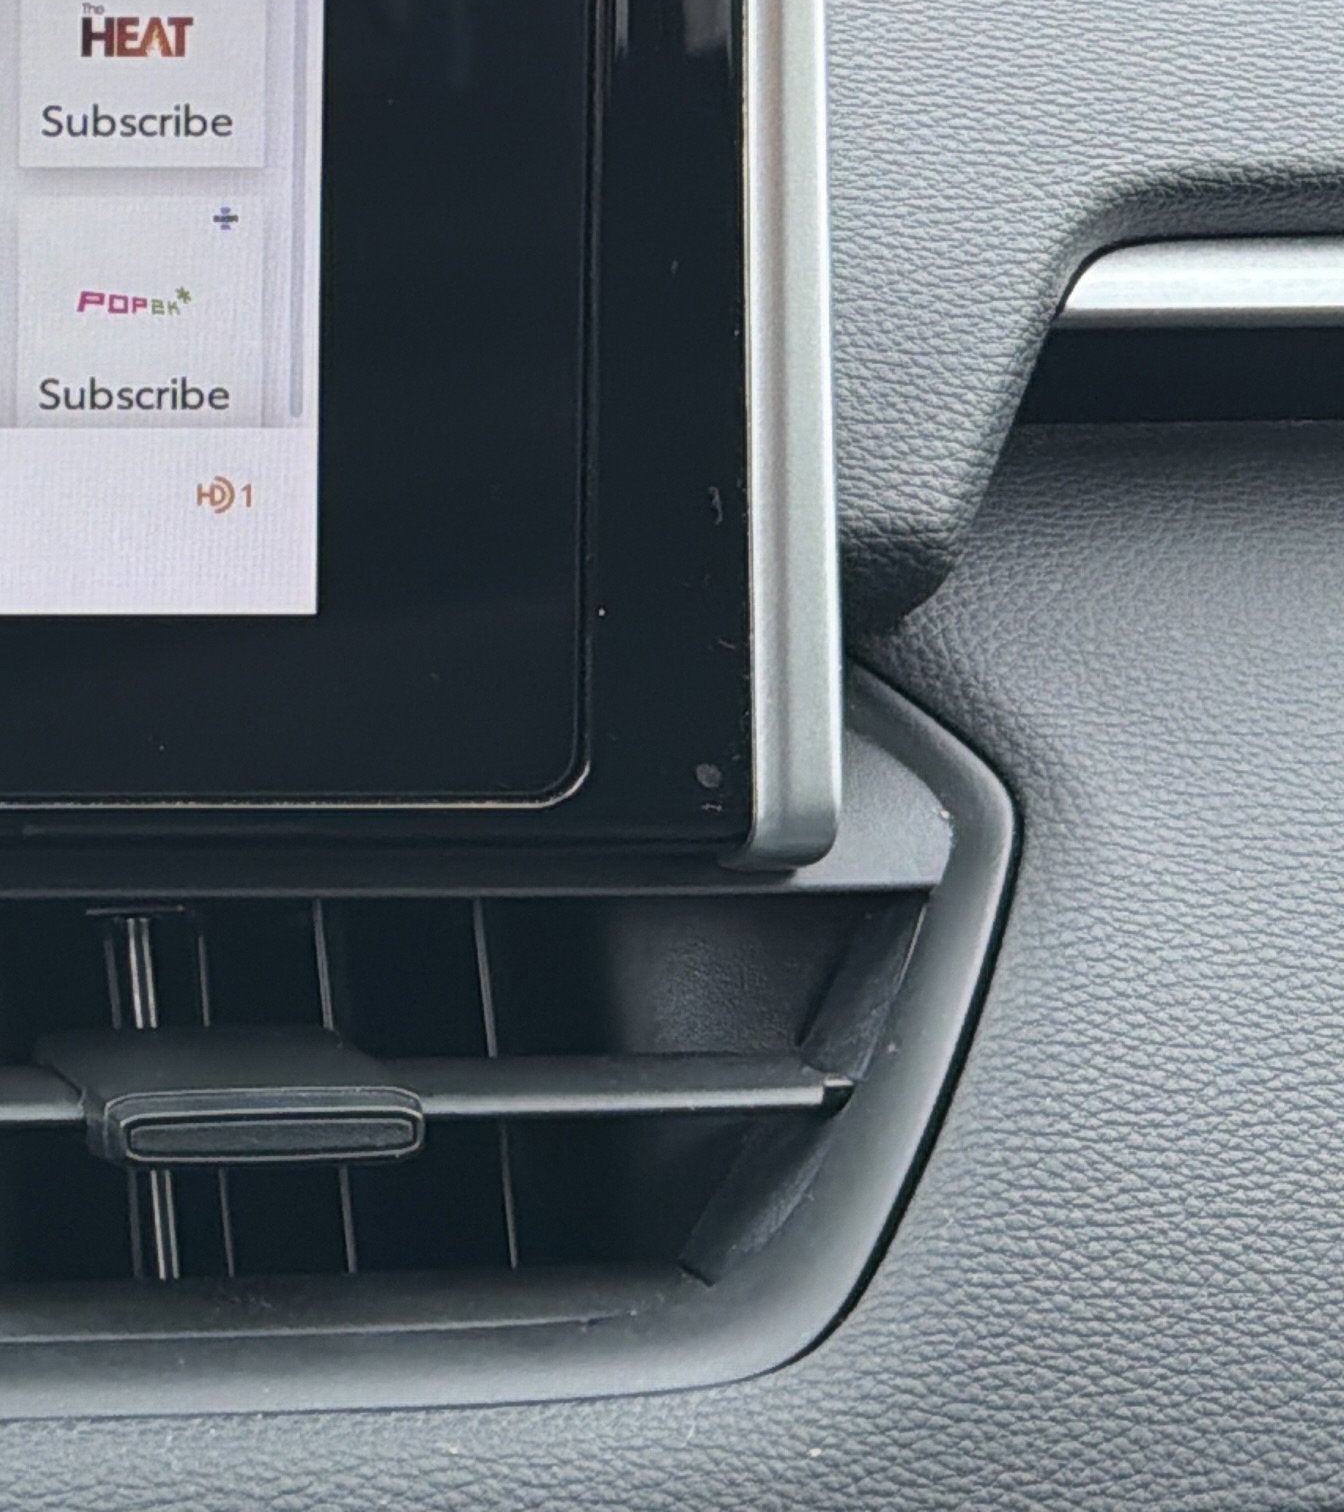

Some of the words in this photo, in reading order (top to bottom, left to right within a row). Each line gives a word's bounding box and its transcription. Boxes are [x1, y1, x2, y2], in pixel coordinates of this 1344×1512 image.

[81, 16, 194, 57] HEAT
[41, 103, 233, 138] Subscribe
[39, 376, 230, 411] Subscribe
